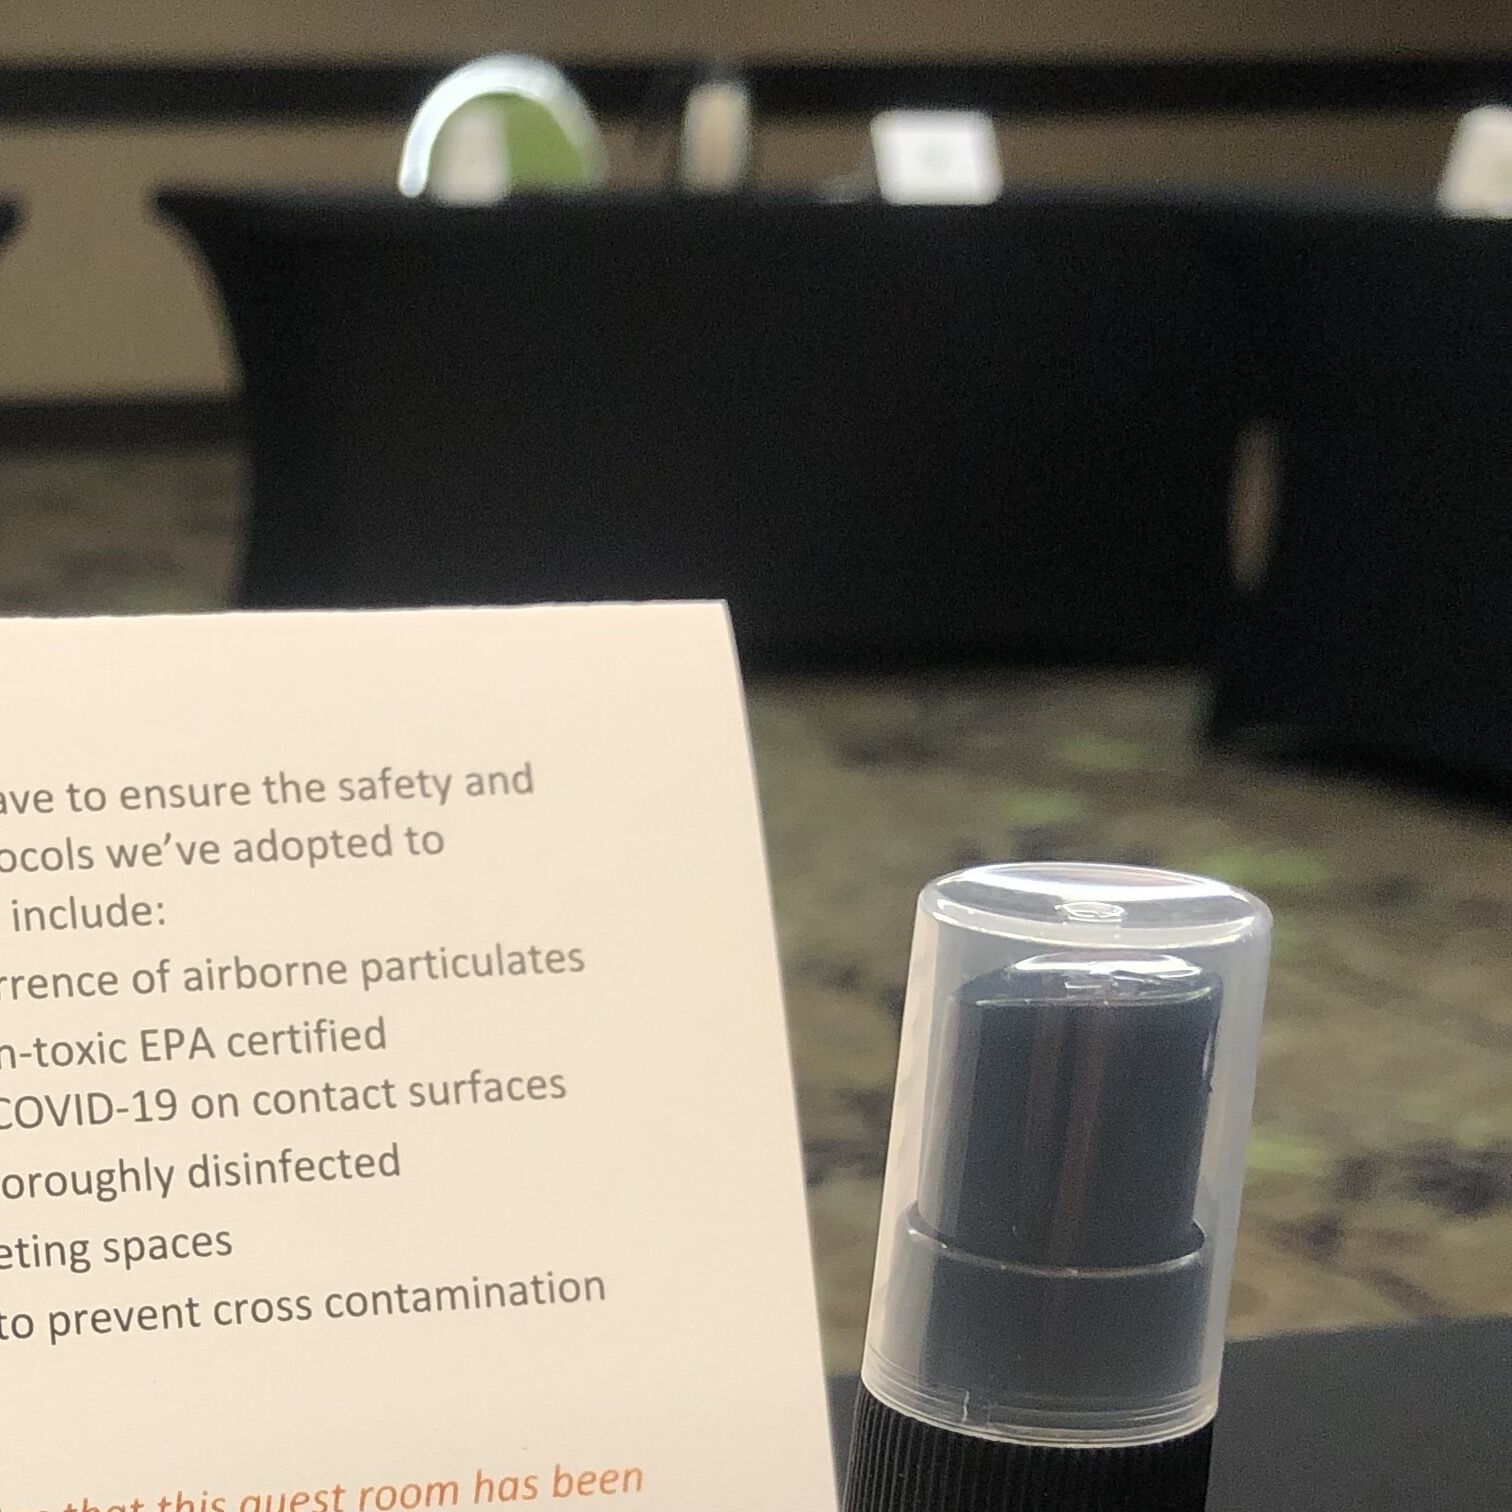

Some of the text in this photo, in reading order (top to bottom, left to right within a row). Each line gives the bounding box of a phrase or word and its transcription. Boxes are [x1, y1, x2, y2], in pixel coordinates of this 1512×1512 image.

[65, 782, 107, 813] to
[119, 781, 252, 811] ensure
[261, 770, 326, 805] the
[338, 766, 453, 807] safety
[465, 761, 534, 797] and
[233, 823, 393, 869] adopted
[403, 826, 445, 856] to
[132, 958, 171, 995] of
[183, 955, 348, 992] airborne
[361, 942, 586, 992] particulates
[190, 1092, 240, 1120] on
[252, 1078, 398, 1117] contact
[408, 1068, 567, 1108] surfaces
[102, 1230, 233, 1272] spaces
[358, 1480, 460, 1512] room
[473, 1468, 539, 1505] has
[552, 1463, 643, 1498] been
